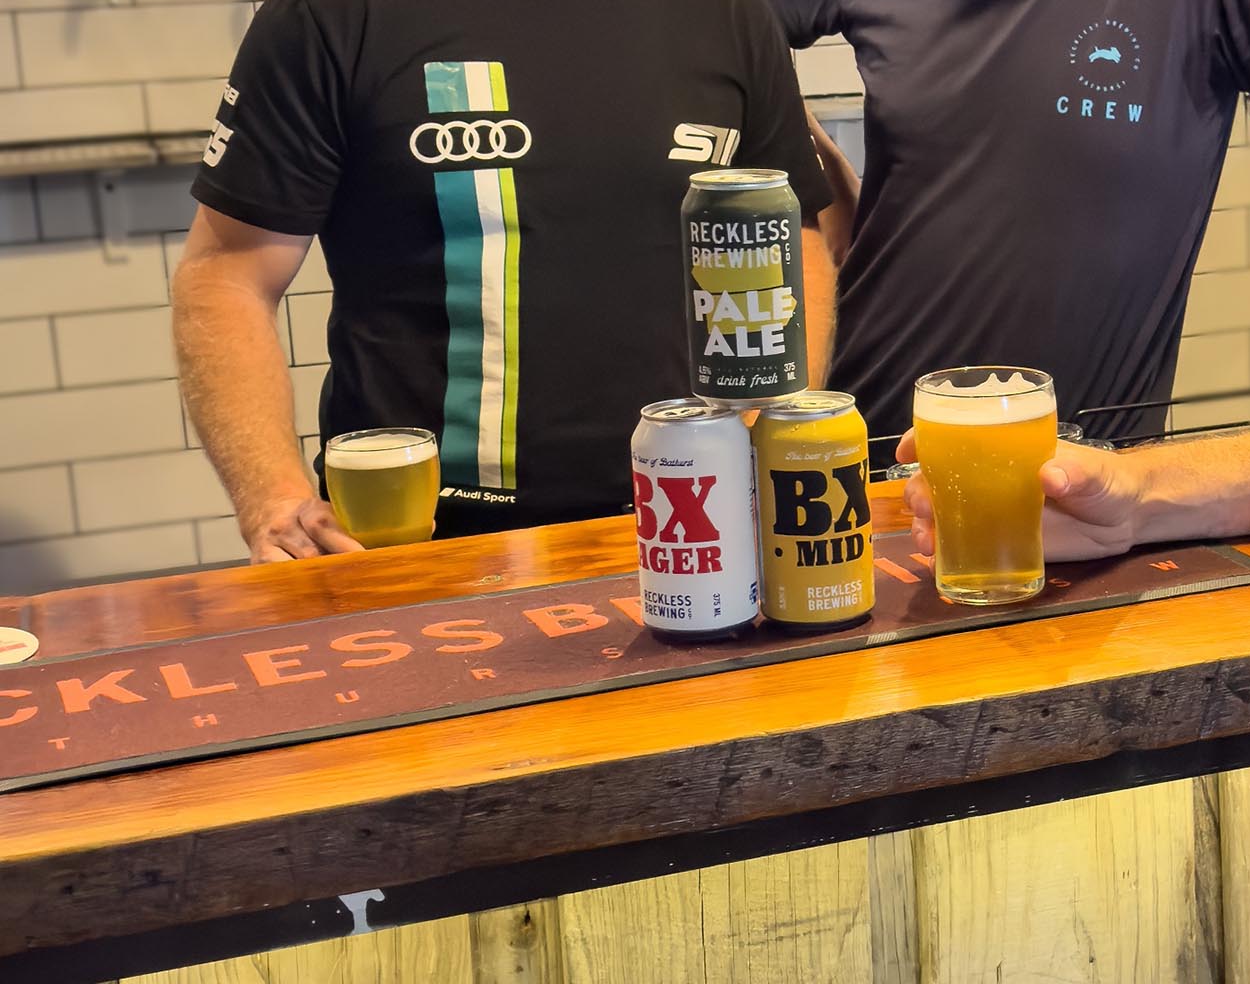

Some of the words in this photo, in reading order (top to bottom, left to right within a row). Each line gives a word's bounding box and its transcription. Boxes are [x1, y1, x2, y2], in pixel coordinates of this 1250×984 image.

[1056, 95, 1143, 123] CREW
[690, 218, 791, 245] RECKLESS
[691, 244, 782, 270] BREWING
[693, 286, 794, 322] PALE
[703, 322, 786, 358] ALE
[783, 361, 796, 372] 375
[716, 375, 747, 387] drink
[749, 372, 779, 389] fresh
[650, 458, 659, 468] of
[659, 457, 695, 468] Bathurst
[454, 489, 481, 500] Audi
[483, 492, 517, 504] Sport
[632, 469, 722, 544] BX
[769, 457, 871, 537] BX
[638, 545, 724, 575] AGER
[795, 533, 864, 568] MID
[643, 588, 692, 607] RECKLESS
[712, 592, 721, 606] 375
[807, 579, 863, 599] RECKLESS
[644, 601, 686, 620] BREWING
[808, 594, 858, 611] BREWING
